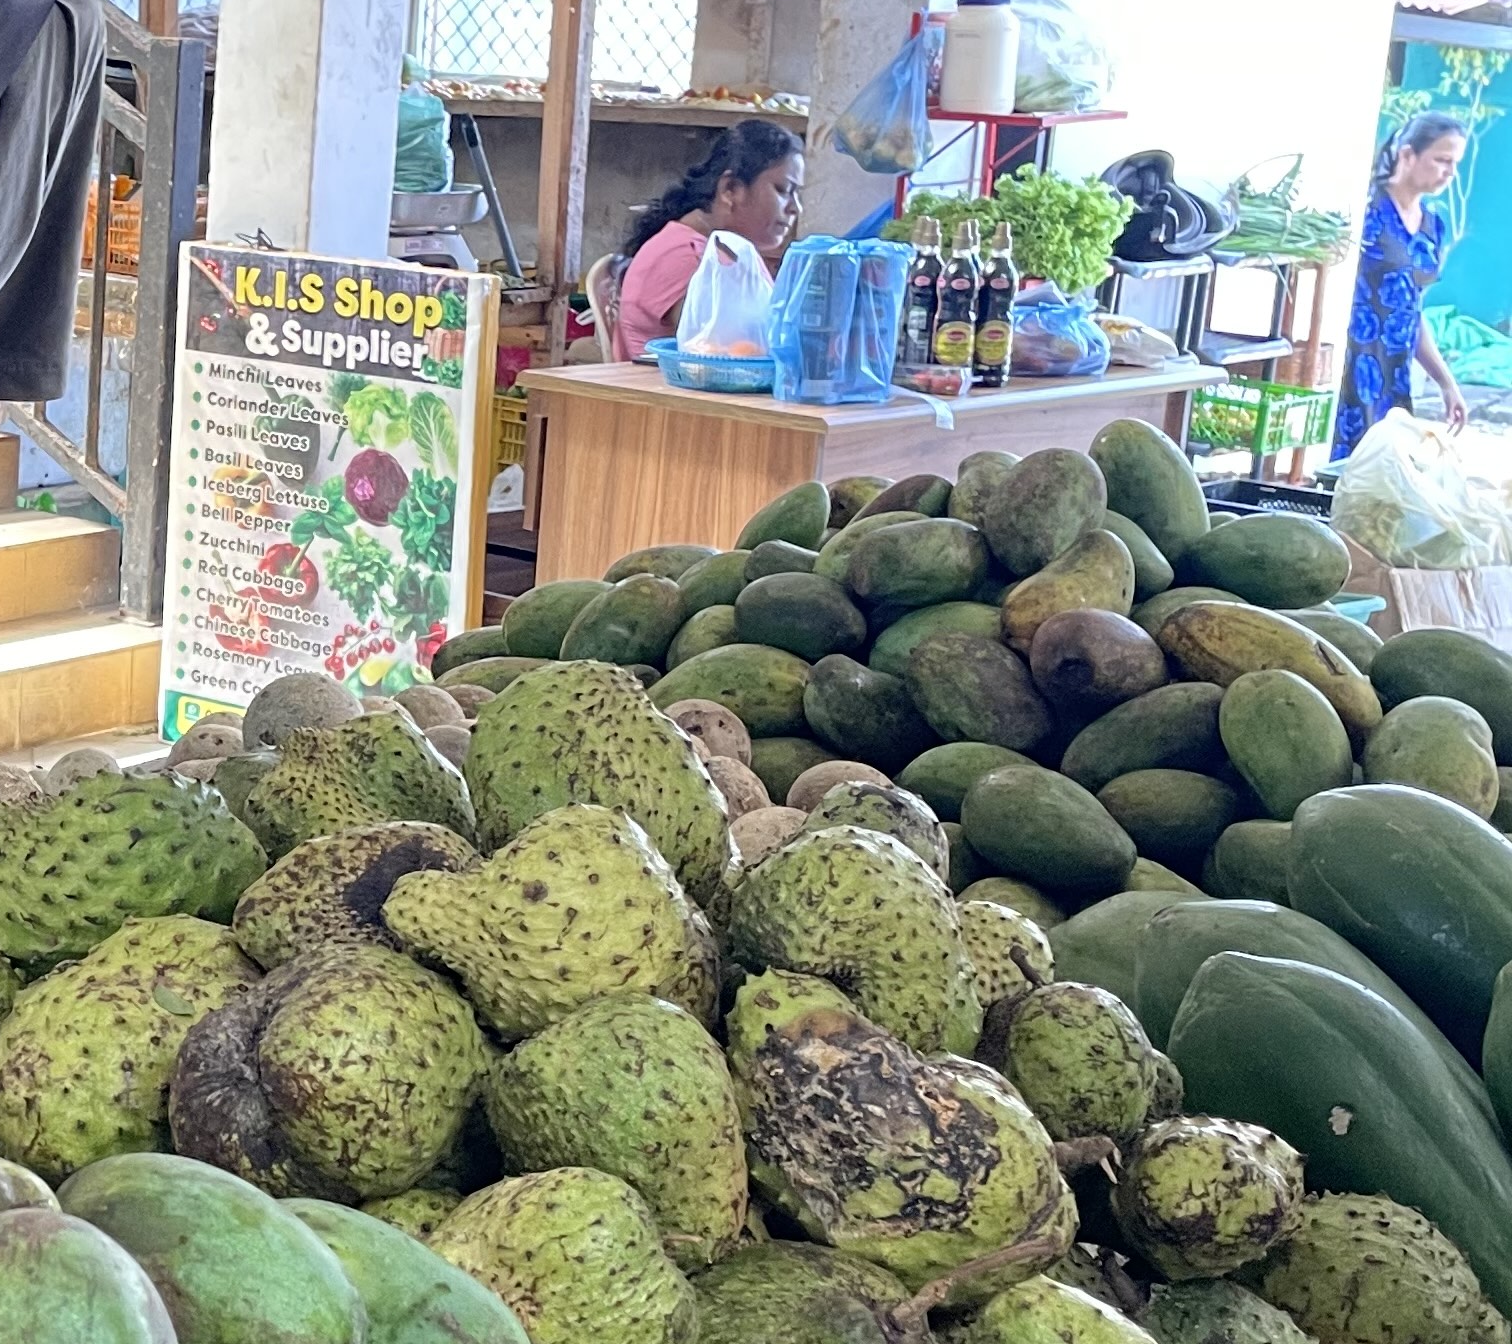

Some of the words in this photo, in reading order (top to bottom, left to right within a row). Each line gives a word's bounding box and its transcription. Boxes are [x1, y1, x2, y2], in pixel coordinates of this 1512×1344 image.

[235, 265, 325, 314] K.I.S
[334, 276, 444, 338] Shop
[245, 311, 280, 357] &
[281, 319, 429, 371] Supplier
[266, 371, 323, 393] Leaves
[207, 391, 287, 418] Coriander
[291, 403, 349, 426] Leaves
[251, 429, 308, 450] Leaves
[204, 448, 241, 468] Basil
[246, 455, 302, 478] Leaves
[202, 476, 261, 503] Iceberg
[201, 503, 230, 521] Bell
[234, 510, 292, 533] Pepper
[199, 532, 265, 557] Zucchini
[198, 559, 228, 578] Red
[232, 567, 305, 594] Cabbage
[196, 587, 249, 613] Cherry
[253, 598, 330, 627] Tomatoes
[194, 615, 256, 639] Chinese
[260, 628, 333, 657] Cabbage
[192, 642, 271, 674] Rosemary
[191, 669, 237, 692] Green
